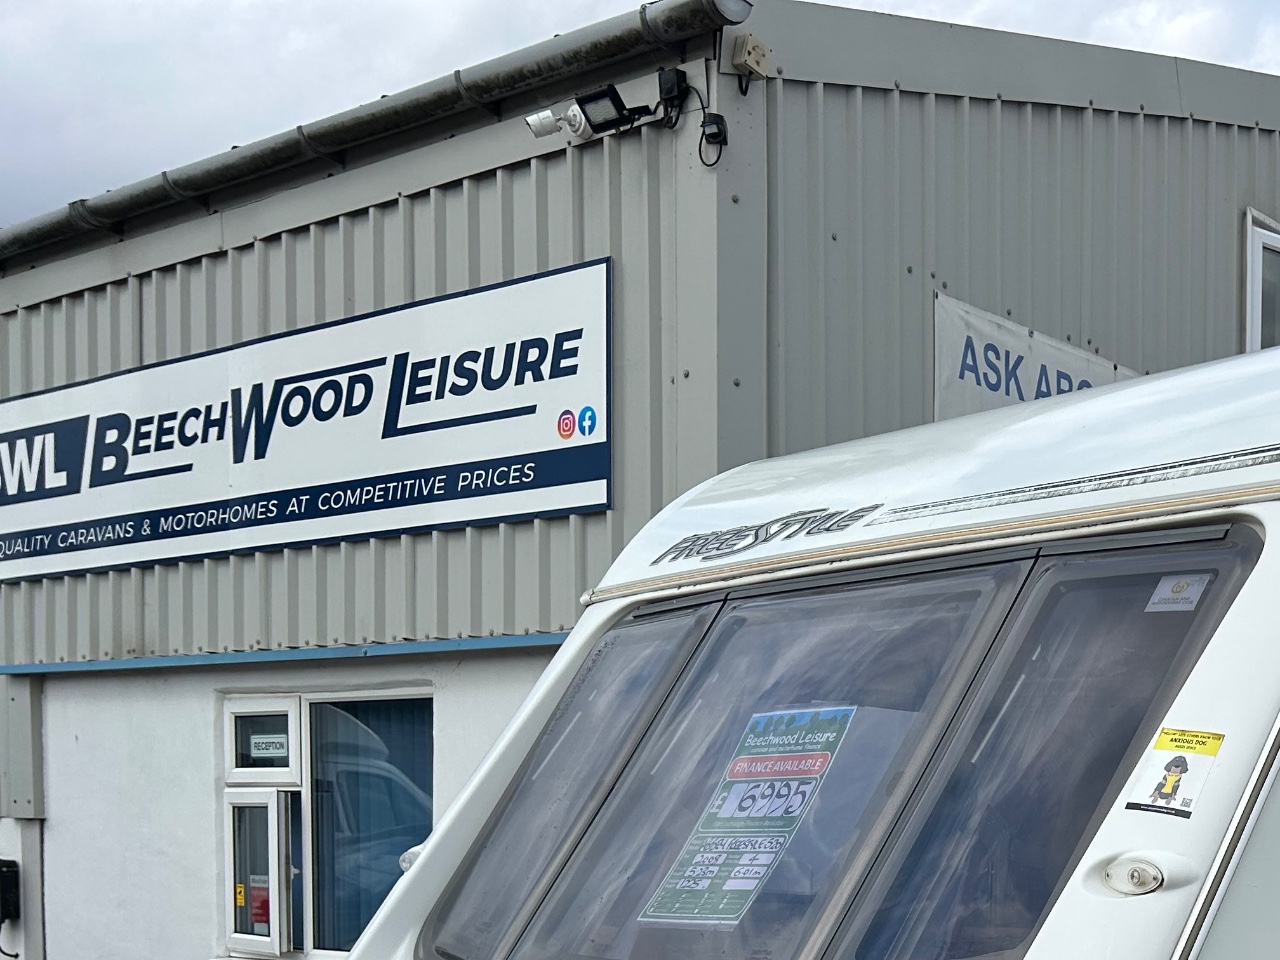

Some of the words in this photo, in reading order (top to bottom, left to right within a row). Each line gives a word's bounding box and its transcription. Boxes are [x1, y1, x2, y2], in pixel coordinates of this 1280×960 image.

[958, 335, 1026, 402] ASK
[1033, 364, 1094, 400] AB
[0, 432, 68, 496] WL
[381, 328, 584, 439] LEISURE
[57, 519, 135, 549] CARAVANS
[141, 519, 152, 536] &
[159, 499, 278, 534] MOTORHOMES
[286, 495, 308, 515] AT
[317, 474, 446, 512] COMPETITIVE
[457, 462, 536, 493] PRICES
[649, 502, 885, 567] FREESTYLE
[253, 741, 285, 751] RECEPTION
[744, 730, 801, 747] Beechwood
[799, 729, 837, 744] Leisure
[733, 760, 774, 773] FINANCE
[773, 758, 824, 772] AVAILABLE
[737, 781, 813, 816] 6995
